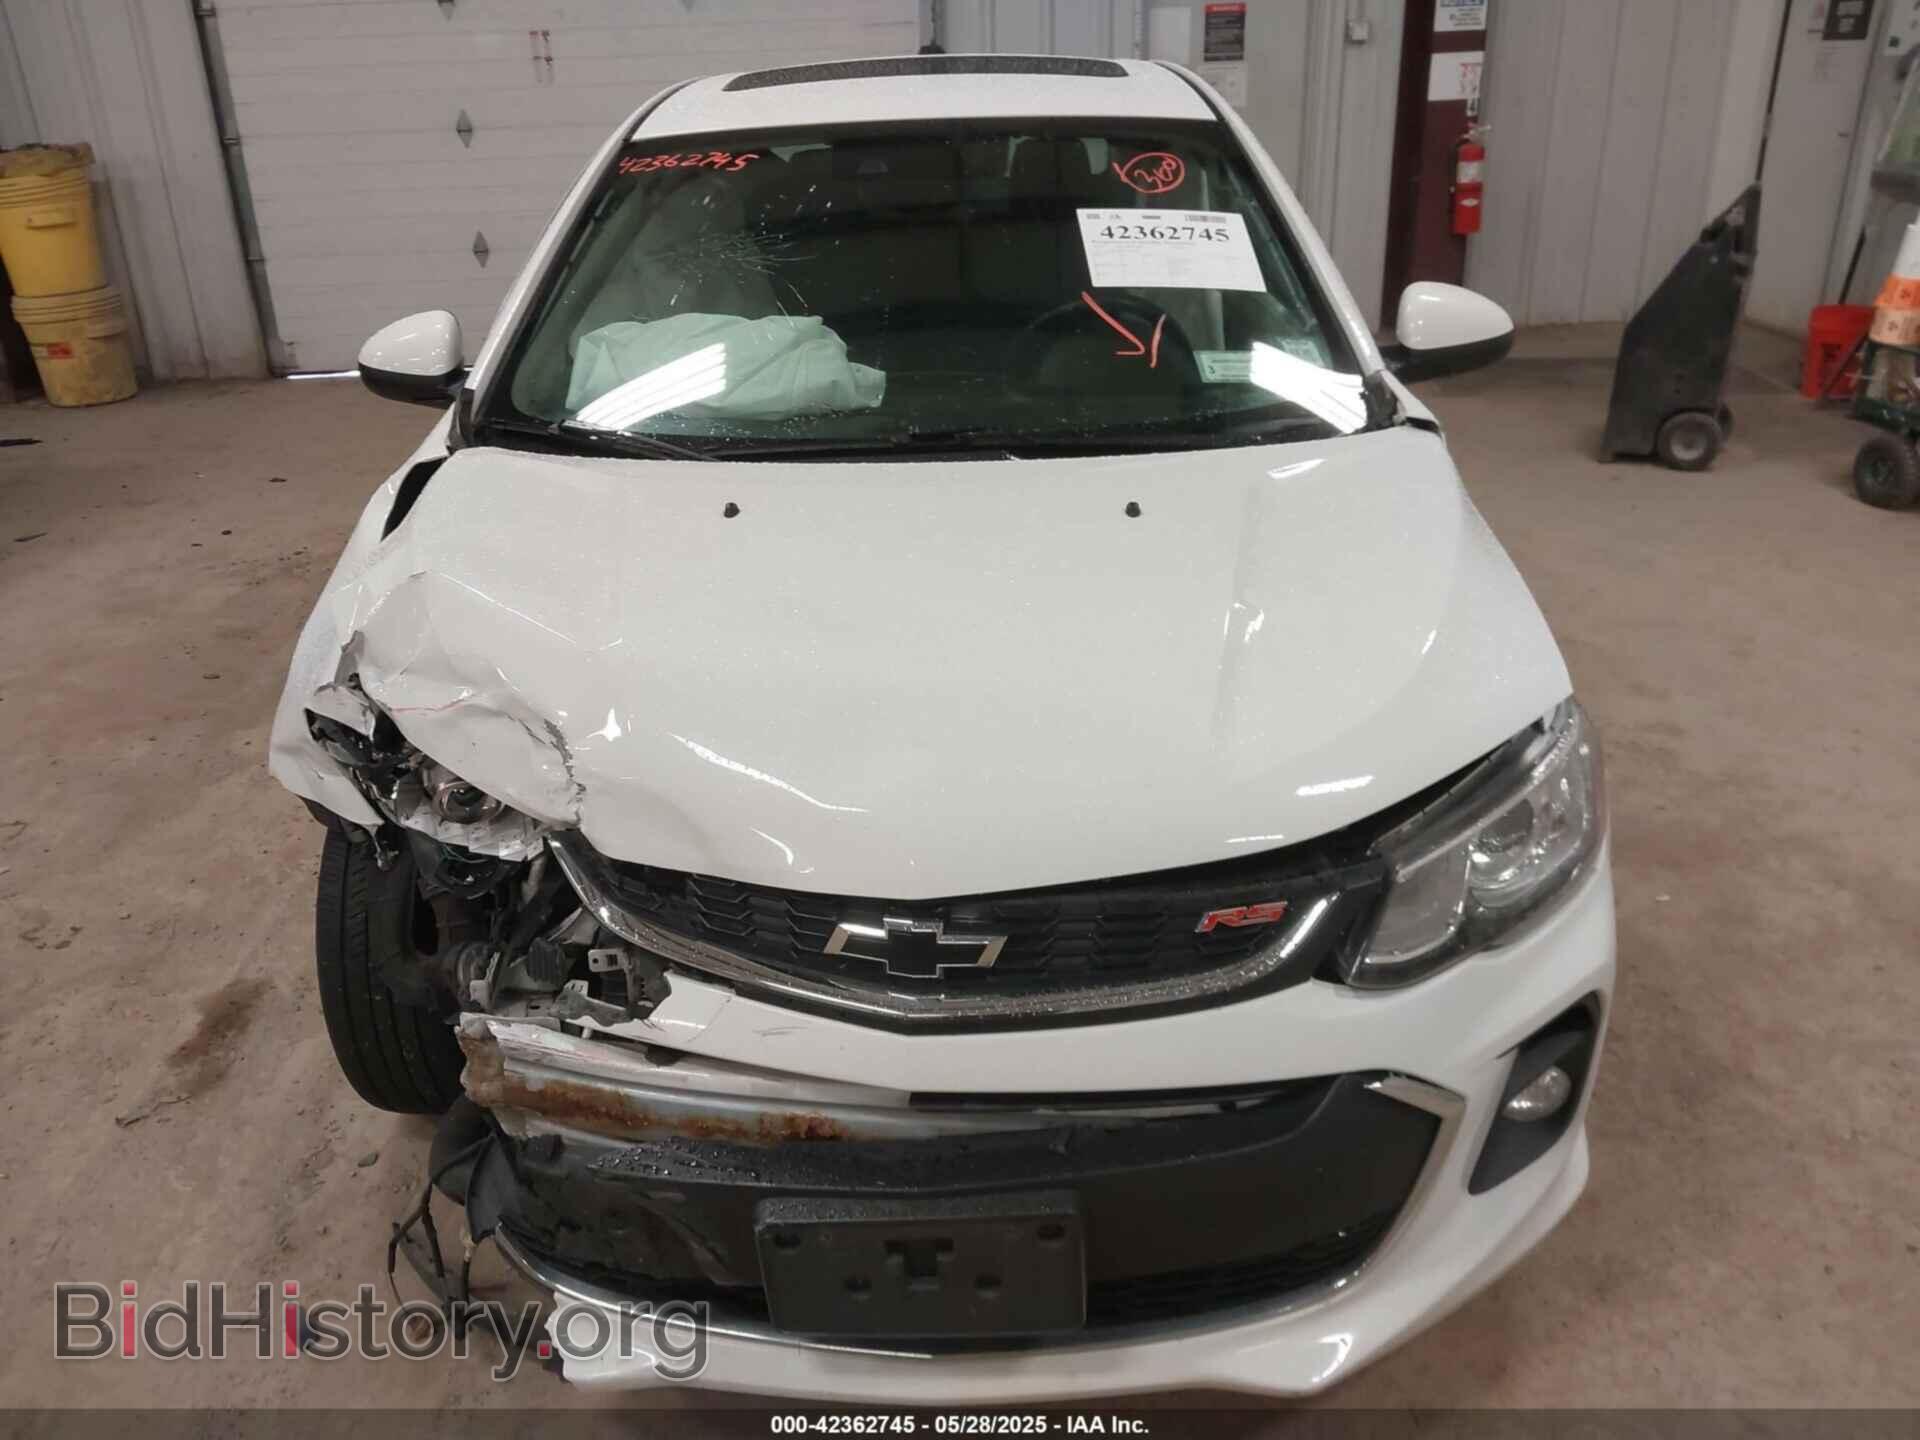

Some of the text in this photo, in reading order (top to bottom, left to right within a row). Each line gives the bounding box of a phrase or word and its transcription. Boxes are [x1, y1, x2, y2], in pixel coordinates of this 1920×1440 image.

[619, 151, 760, 174] 42362745
[1100, 224, 1230, 243] 42362745
[1194, 901, 1288, 933] RS
